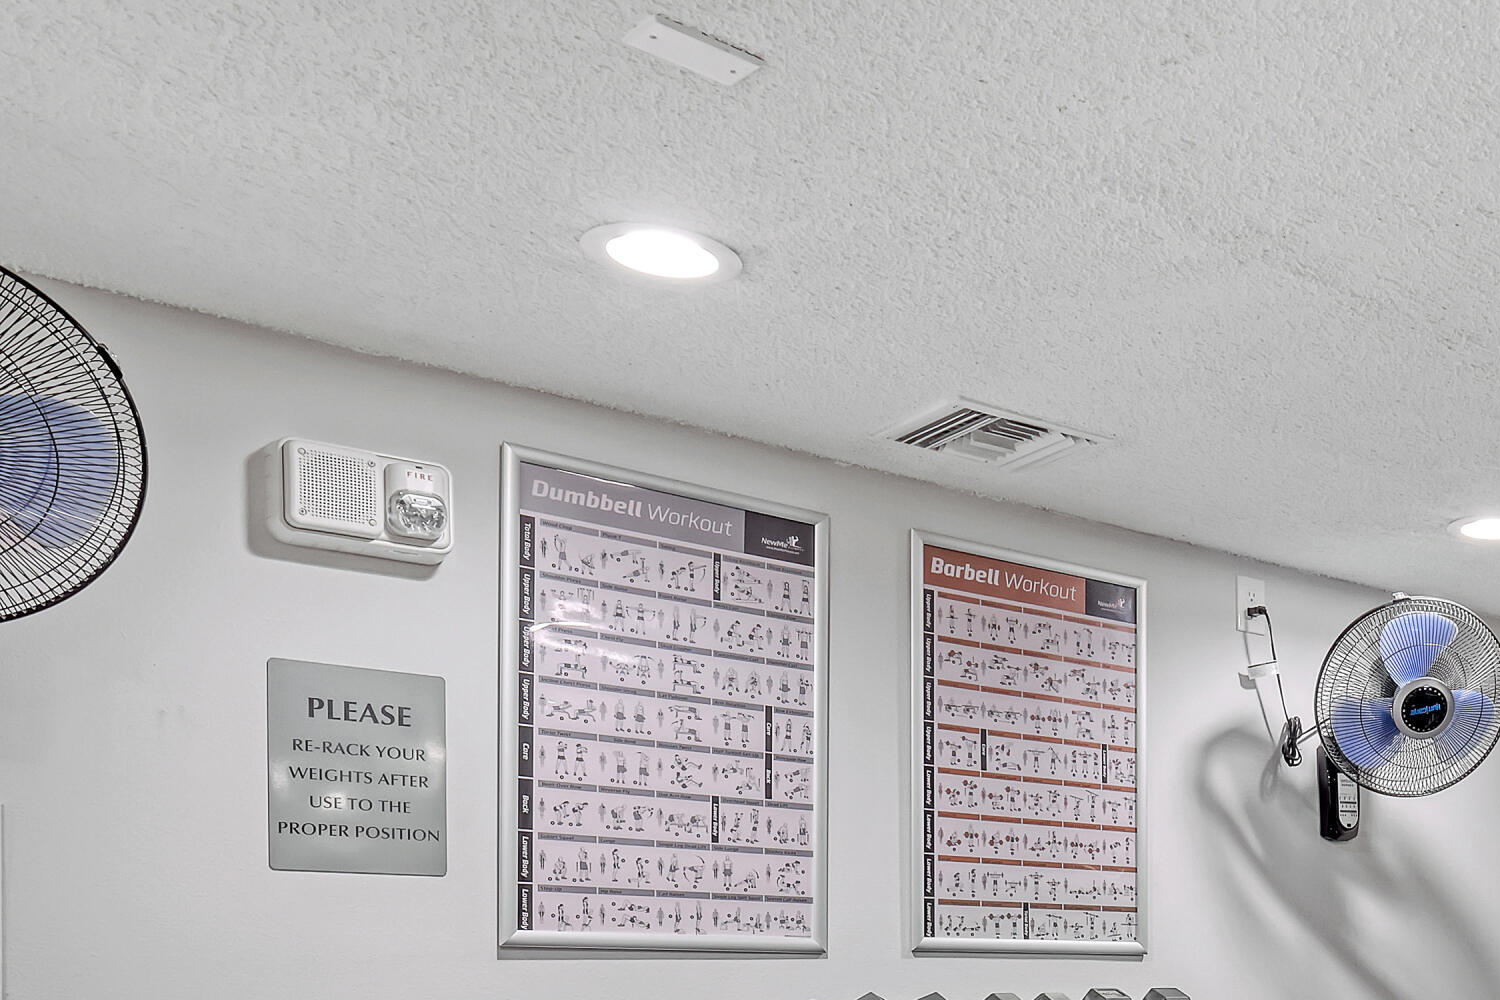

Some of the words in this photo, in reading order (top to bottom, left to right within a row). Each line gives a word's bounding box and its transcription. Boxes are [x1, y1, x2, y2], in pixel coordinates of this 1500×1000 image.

[407, 472, 433, 481] FIRE
[531, 480, 642, 517] Dumbbell
[648, 503, 733, 537] Workout
[523, 538, 531, 560] Body
[523, 573, 531, 591] Upper
[931, 557, 1000, 586] Barbell
[1004, 571, 1077, 601] Workout
[522, 591, 531, 614] Body
[523, 626, 531, 645] Upper
[522, 645, 530, 668] Body
[522, 678, 530, 697] Upper
[308, 697, 411, 727] PLEASE
[521, 697, 530, 720] Body
[292, 739, 370, 757] RE-RACK
[375, 745, 425, 761] YOUR
[522, 742, 530, 760] Core
[289, 766, 373, 784] WEIGHTS
[378, 773, 429, 788] AFTER
[309, 795, 342, 809] USE
[347, 798, 373, 811] TO
[378, 800, 411, 813] THE
[521, 794, 529, 814] Back
[278, 821, 349, 837] PROPER
[355, 825, 440, 841] POSITION
[521, 858, 529, 878] Body
[521, 911, 529, 930] Body
